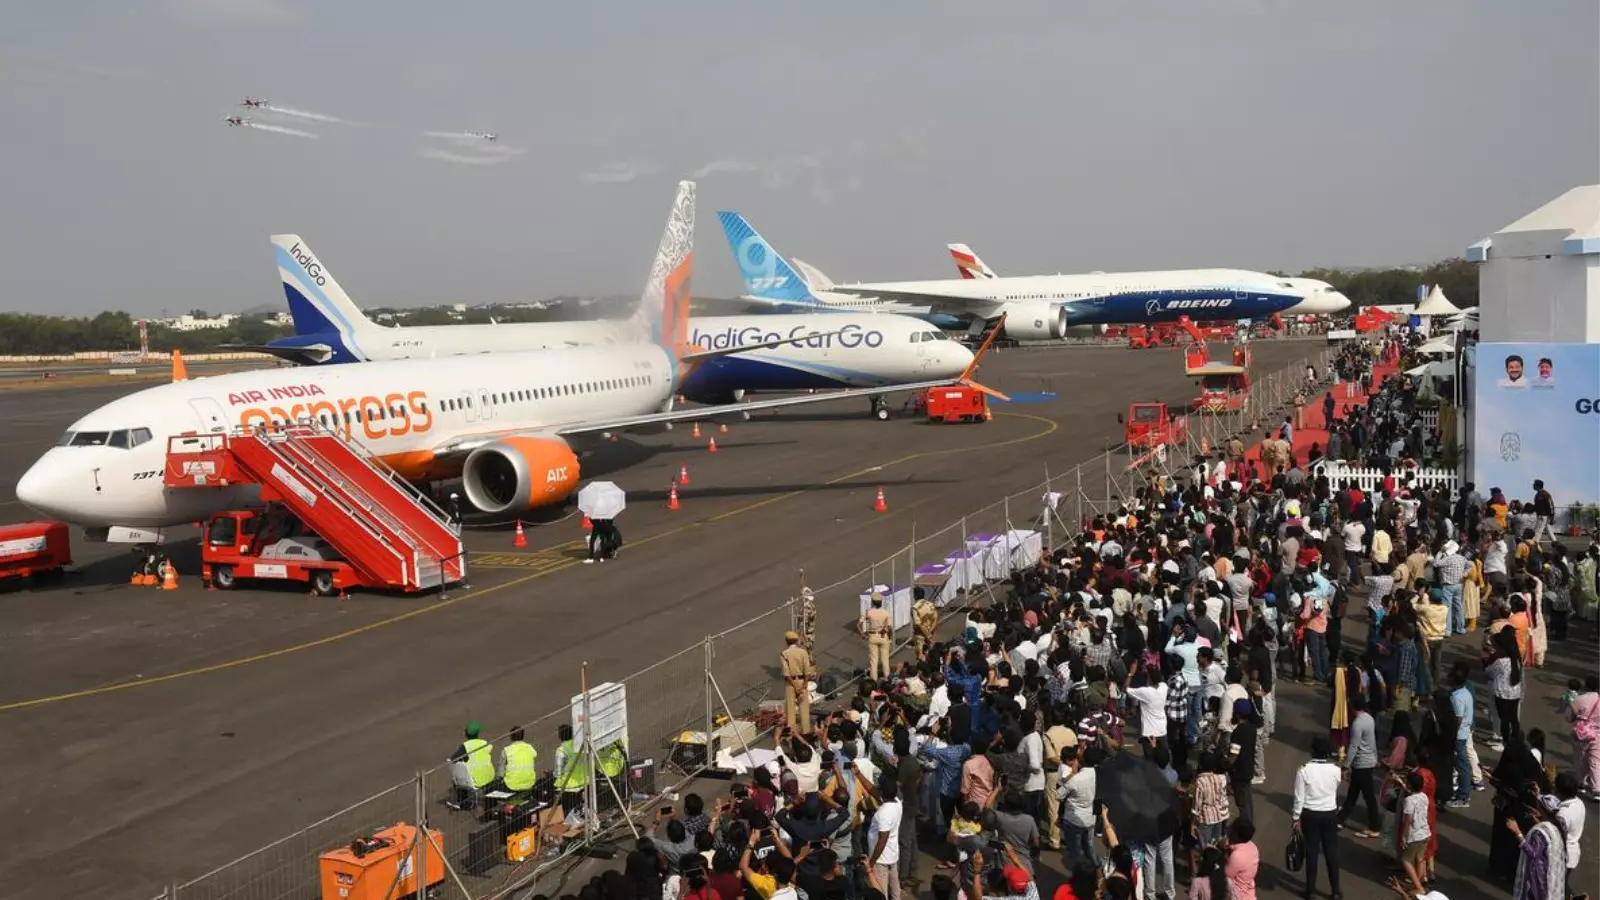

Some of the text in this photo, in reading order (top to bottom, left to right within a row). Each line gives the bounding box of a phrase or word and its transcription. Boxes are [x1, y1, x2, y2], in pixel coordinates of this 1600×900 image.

[290, 242, 326, 287] IndiGo
[752, 276, 789, 289] 777
[1166, 299, 1233, 309] BOEING
[693, 324, 884, 350] IndiGo CarGo
[228, 384, 325, 406] AIR INDIA
[546, 466, 569, 483] AIX
